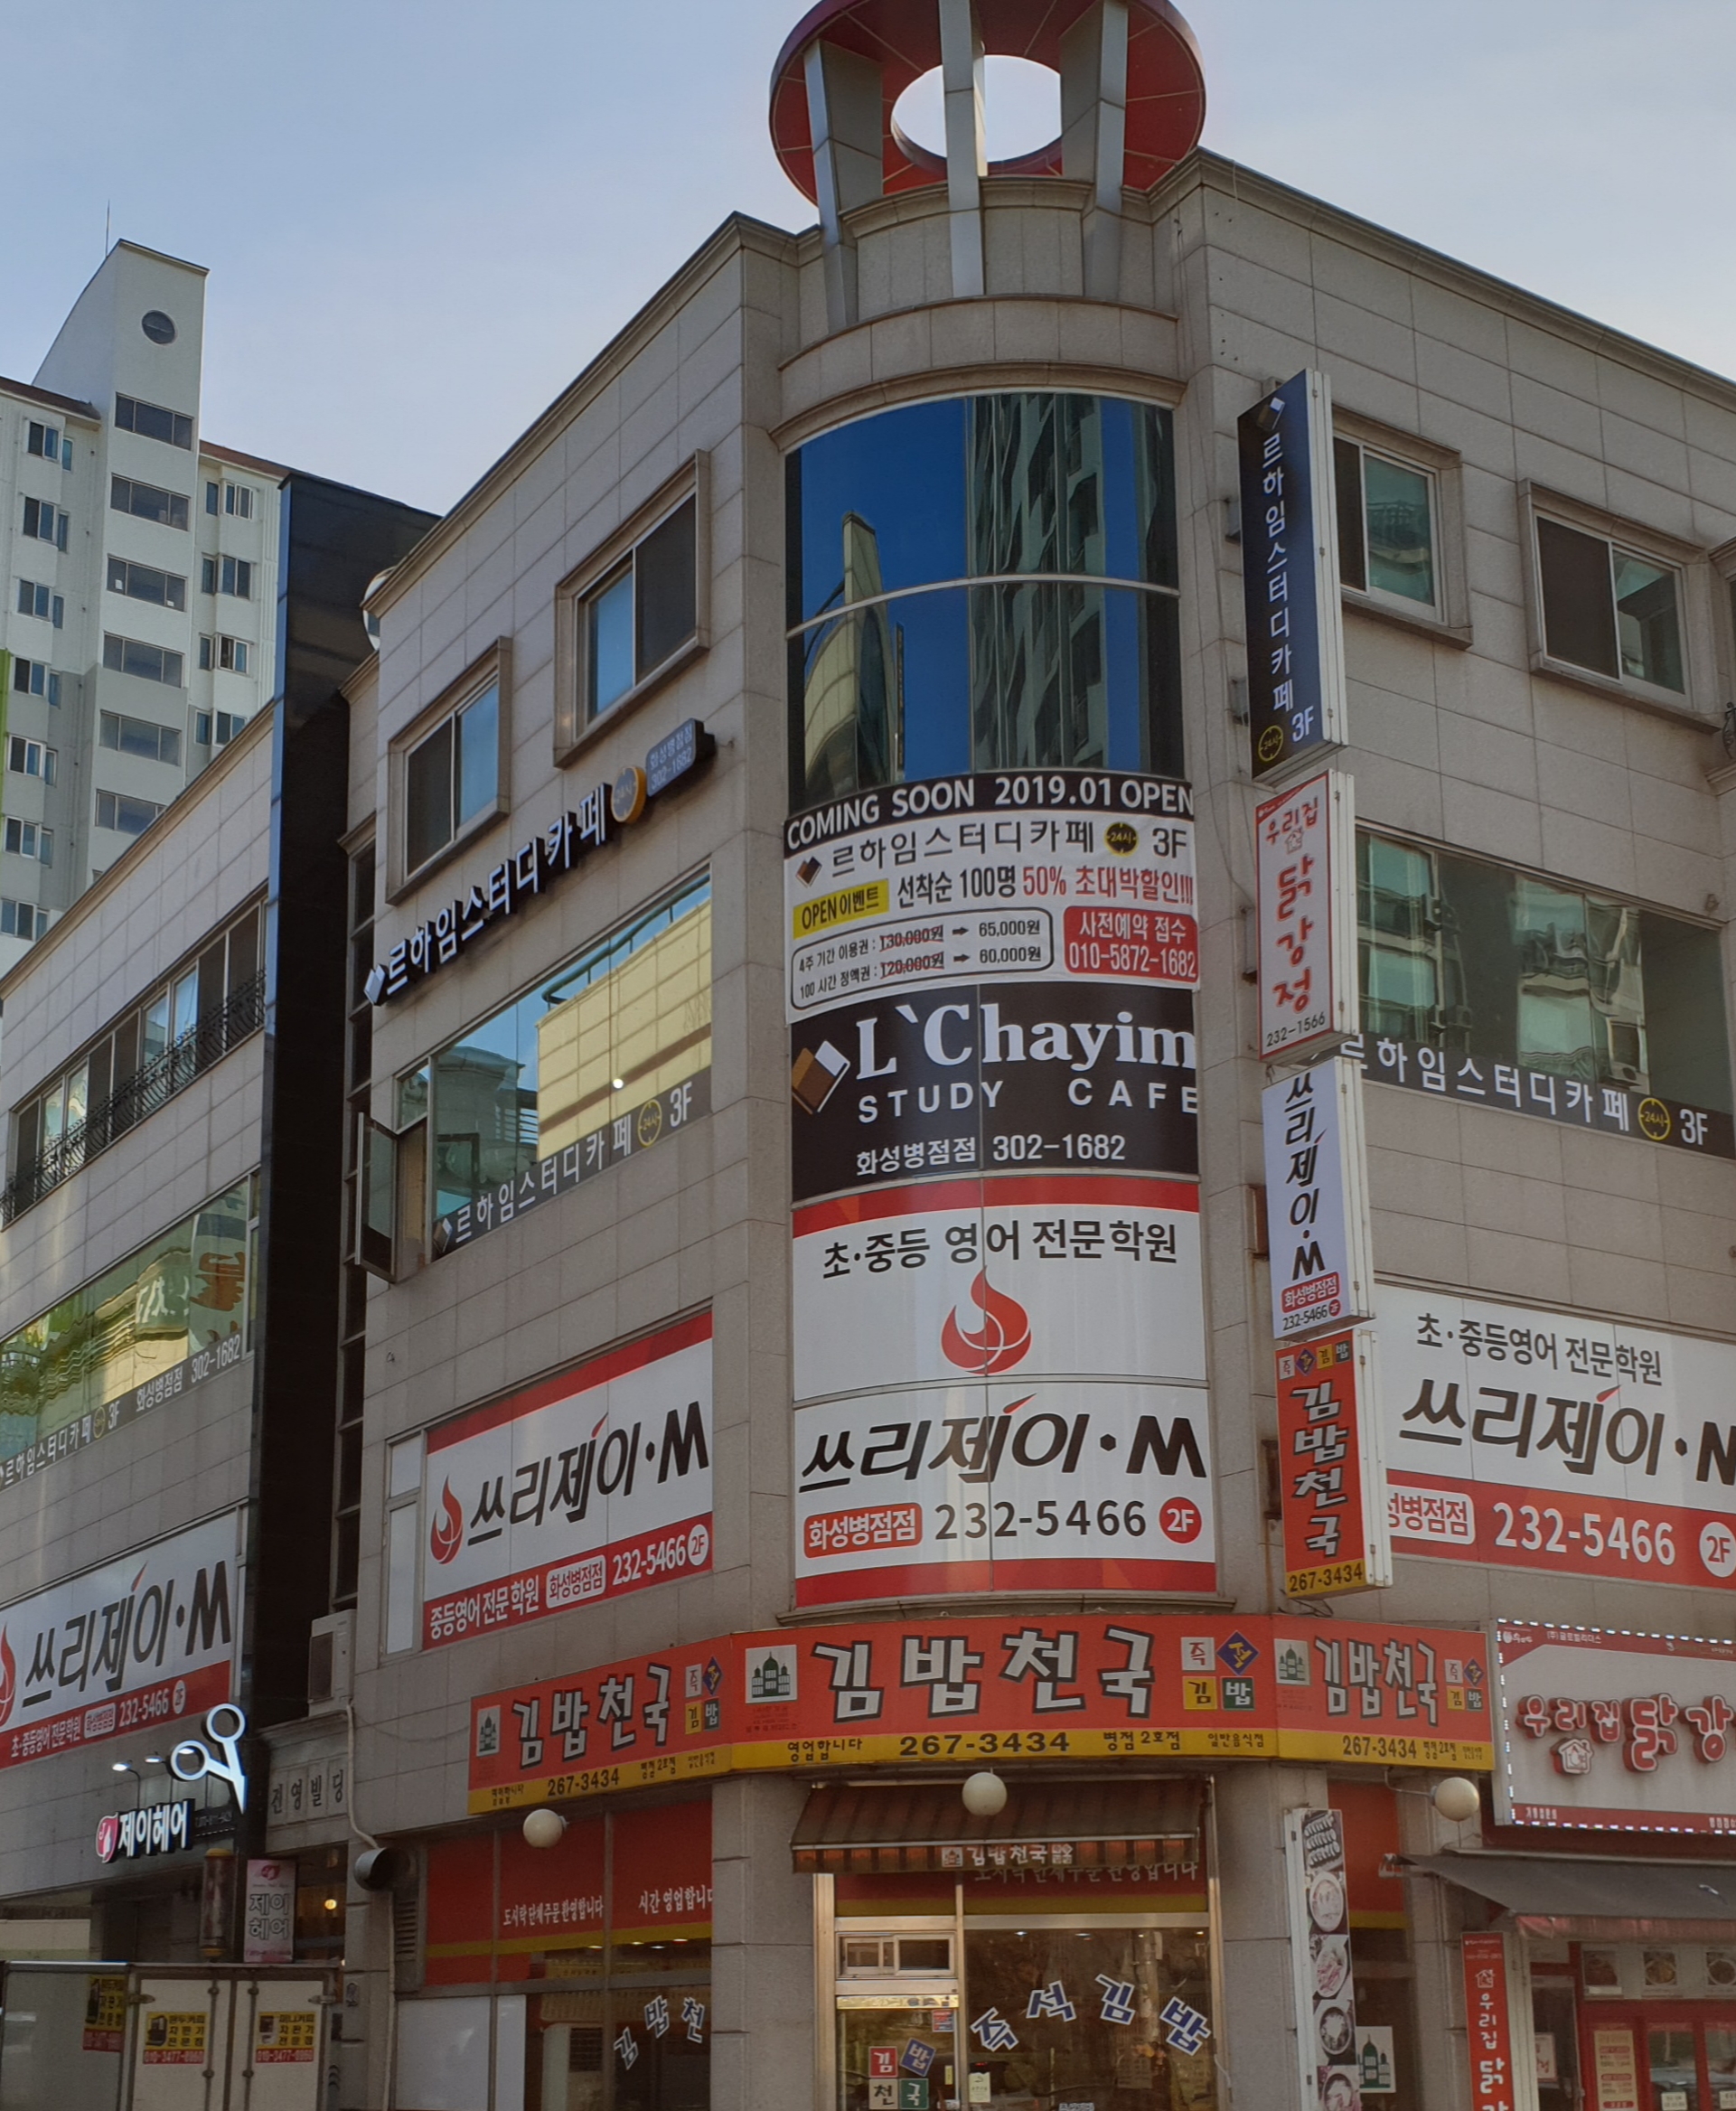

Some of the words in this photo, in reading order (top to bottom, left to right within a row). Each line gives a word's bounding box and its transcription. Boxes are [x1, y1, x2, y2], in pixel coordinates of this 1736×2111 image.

[1262, 432, 1294, 713] 르하임스터디카페
[1291, 706, 1314, 742] 3F
[787, 795, 879, 849] COMING
[892, 780, 974, 818] SOON
[995, 777, 1112, 807] 2019.01
[1121, 780, 1193, 815] OPEN
[1265, 796, 1318, 845] 우리집
[831, 821, 1093, 878] 르하임스터디카페
[1152, 827, 1187, 858] 3F
[387, 783, 606, 995] 르하임스터디카페
[802, 896, 837, 930] OPEN
[840, 886, 879, 915] 이벤트
[897, 875, 952, 909] 선착순
[960, 866, 1015, 898] 100명
[1023, 866, 1066, 896] 50%
[1075, 866, 1193, 905] 초대박할인!!!
[799, 958, 814, 972] 4주
[817, 949, 835, 966] 기간
[839, 940, 868, 961] 이용권
[980, 921, 1040, 937] 65,000원
[1080, 915, 1150, 941] 사전예약
[1154, 915, 1187, 944] 접수
[1273, 853, 1314, 1013] 닭강정
[800, 983, 814, 999] 100
[818, 976, 837, 994] 시간
[840, 966, 870, 987] 정액권
[980, 947, 1041, 964] 60,000원
[1069, 944, 1196, 977] 010-5872-1682
[1267, 1011, 1326, 1047] 232-1566
[859, 1080, 1003, 1122] STUDY
[1068, 1078, 1197, 1114] CAFE
[1680, 1110, 1708, 1145] 3F
[455, 1115, 631, 1243] 르하임스터디카페
[670, 1082, 692, 1127] 3F
[857, 1138, 976, 1176] 화성병점점
[993, 1134, 1125, 1161] 302-1682
[945, 1221, 1019, 1263] 영어
[1032, 1220, 1177, 1263] 전문학원
[1282, 1305, 1328, 1331] 232-5466
[1284, 1279, 1337, 1310] 화성병점점
[108, 1401, 119, 1430] 3F
[192, 1334, 240, 1383] 302-1682
[1564, 1338, 1662, 1386] 전문학원
[1289, 1379, 1349, 1557] 김밥천국
[809, 1508, 916, 1550] 화성병점점
[935, 1499, 1146, 1539] 232-5466
[1167, 1508, 1194, 1532] 2F
[1493, 1502, 1675, 1566] 232-5466
[1706, 1535, 1731, 1563] 2F
[430, 1593, 480, 1639] 중등영어
[483, 1575, 539, 1625] 전문학원
[549, 1562, 603, 1600] 화성병점점
[613, 1534, 686, 1586] 232-5466
[691, 1534, 705, 1554] 2F
[1289, 1562, 1363, 1593] 267-3434
[812, 1625, 1155, 1722] 김밥천국
[1314, 1637, 1438, 1727] 김밥천국
[119, 1688, 169, 1727] 232-5466
[512, 1663, 671, 1769] 김밥천국
[1516, 1694, 1621, 1743] 우리집
[787, 1738, 862, 1762] 영업합니다
[899, 1731, 1070, 1757] 267-3434
[1103, 1731, 1134, 1751] 병점
[1140, 1730, 1180, 1751] 2호점
[1207, 1731, 1264, 1748] 일반음식점
[1342, 1735, 1416, 1759] 267-3434
[548, 1768, 619, 1797] 267-3434
[118, 1800, 188, 1857] 제이헤어
[967, 1844, 1047, 1867] 김밥천국
[249, 1893, 289, 1916] 제이
[638, 1890, 661, 1915] 시간
[249, 1918, 288, 1940] 헤어
